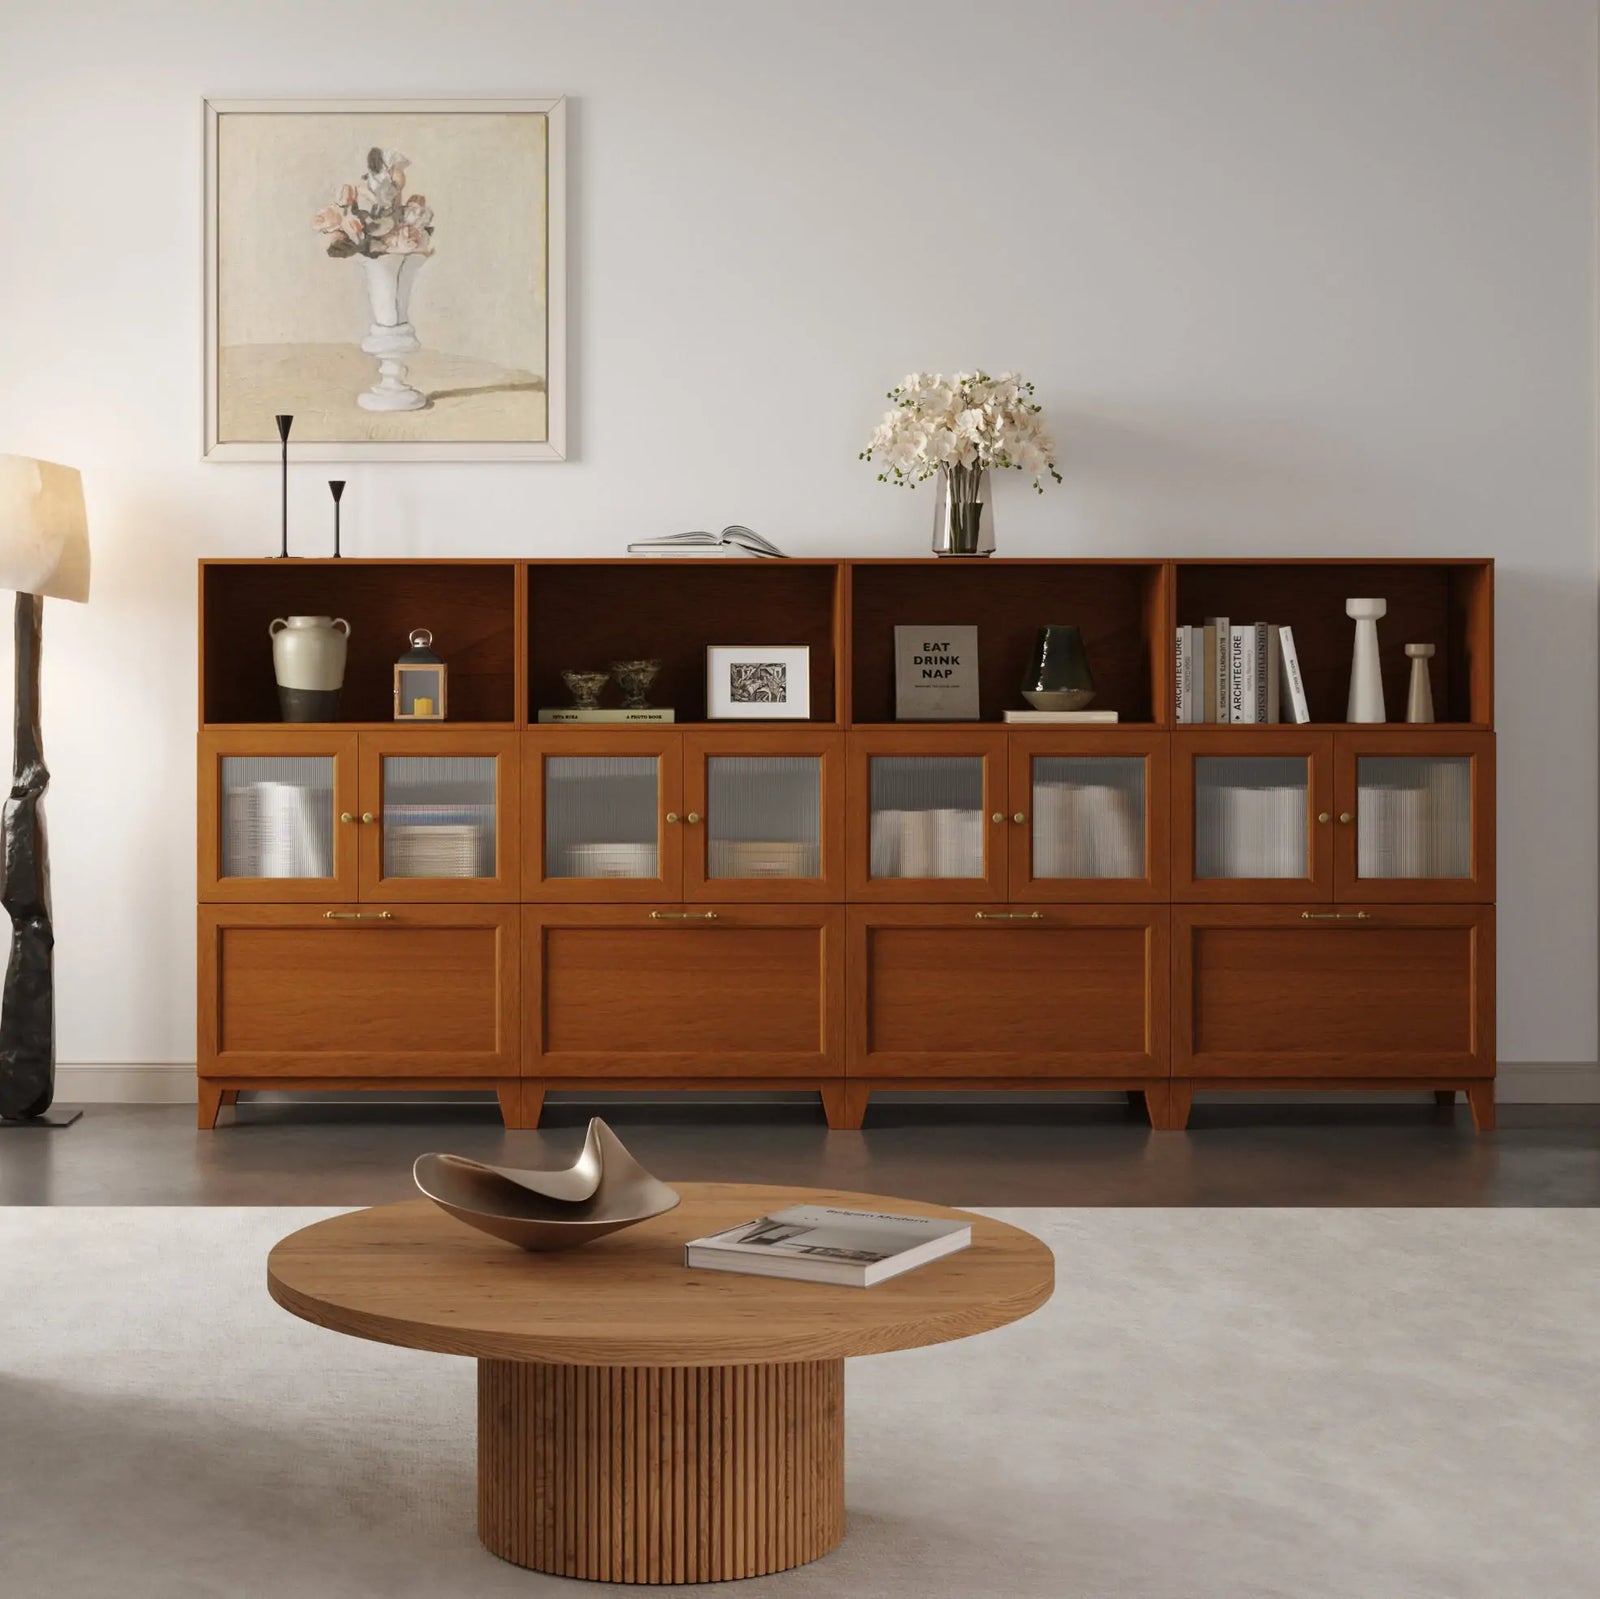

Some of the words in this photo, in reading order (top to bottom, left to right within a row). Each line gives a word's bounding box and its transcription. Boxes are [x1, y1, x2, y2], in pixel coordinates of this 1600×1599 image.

[923, 642, 950, 652] EAT
[1258, 624, 1266, 683] FURNITURE
[913, 655, 960, 665] DRINK
[922, 669, 953, 679] NAP
[1233, 635, 1242, 711] ARCHITECTURE
[1258, 685, 1266, 723] DESIGN
[826, 1209, 874, 1217] Belgian
[877, 1214, 929, 1223] Modern
